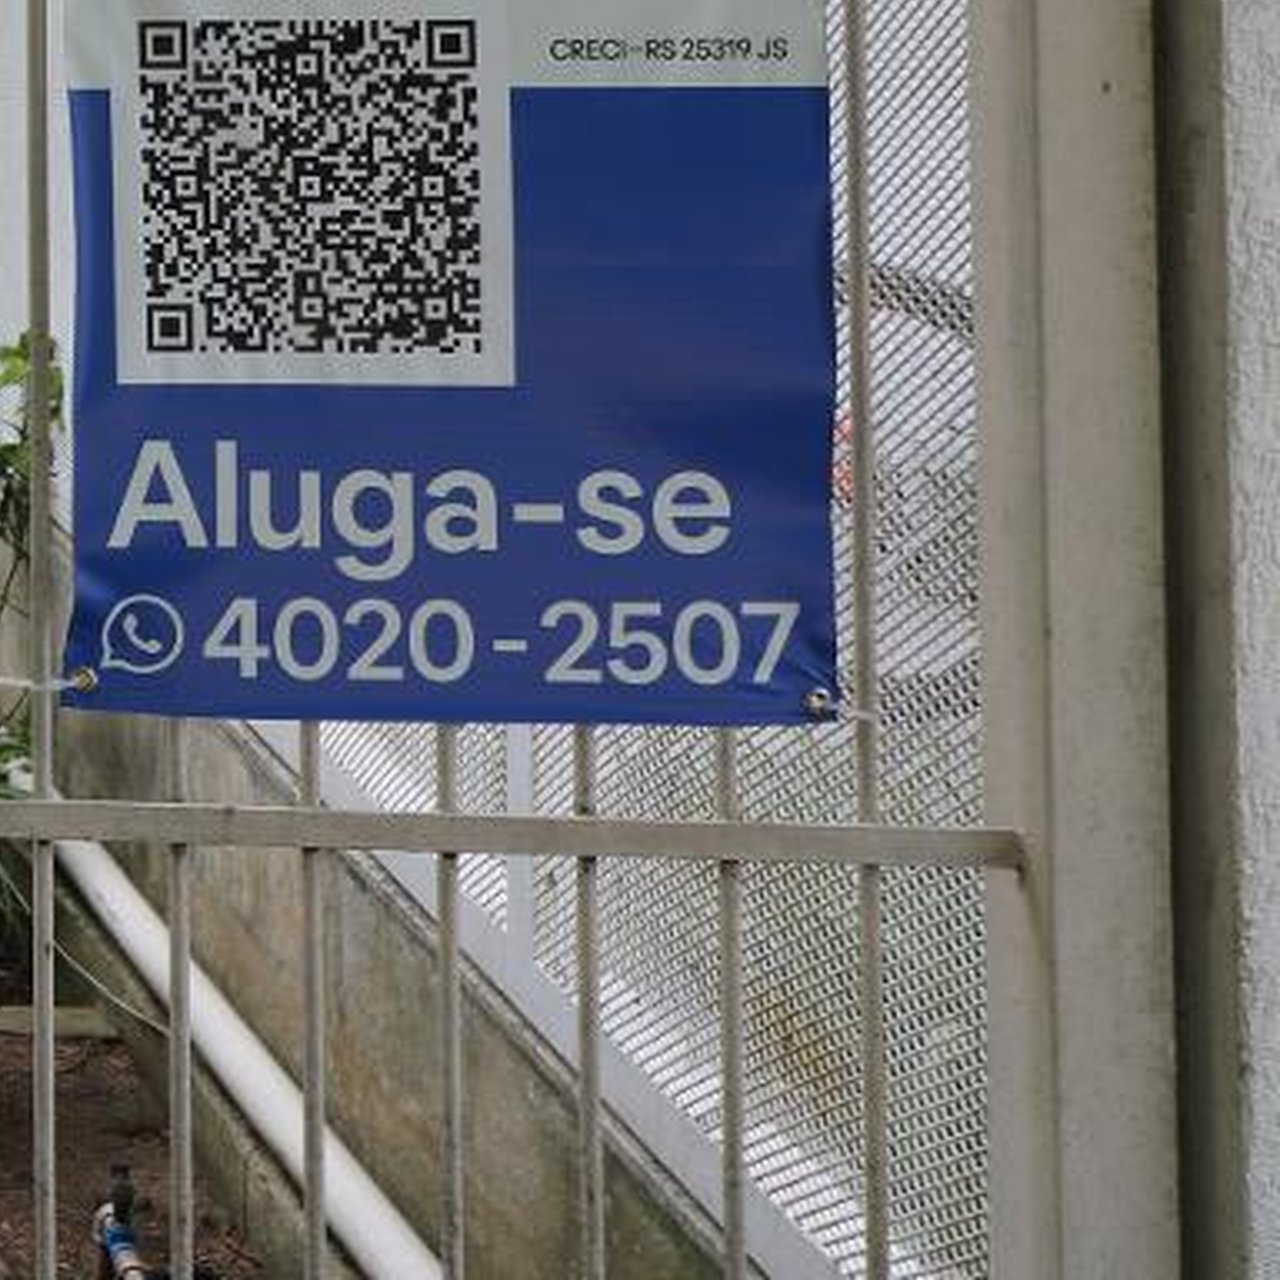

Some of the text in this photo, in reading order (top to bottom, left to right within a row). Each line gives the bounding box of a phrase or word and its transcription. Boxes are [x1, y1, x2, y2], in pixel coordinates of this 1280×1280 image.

[548, 36, 790, 62] CRECI-RS 25319 JS
[104, 439, 734, 582] Aluga-se
